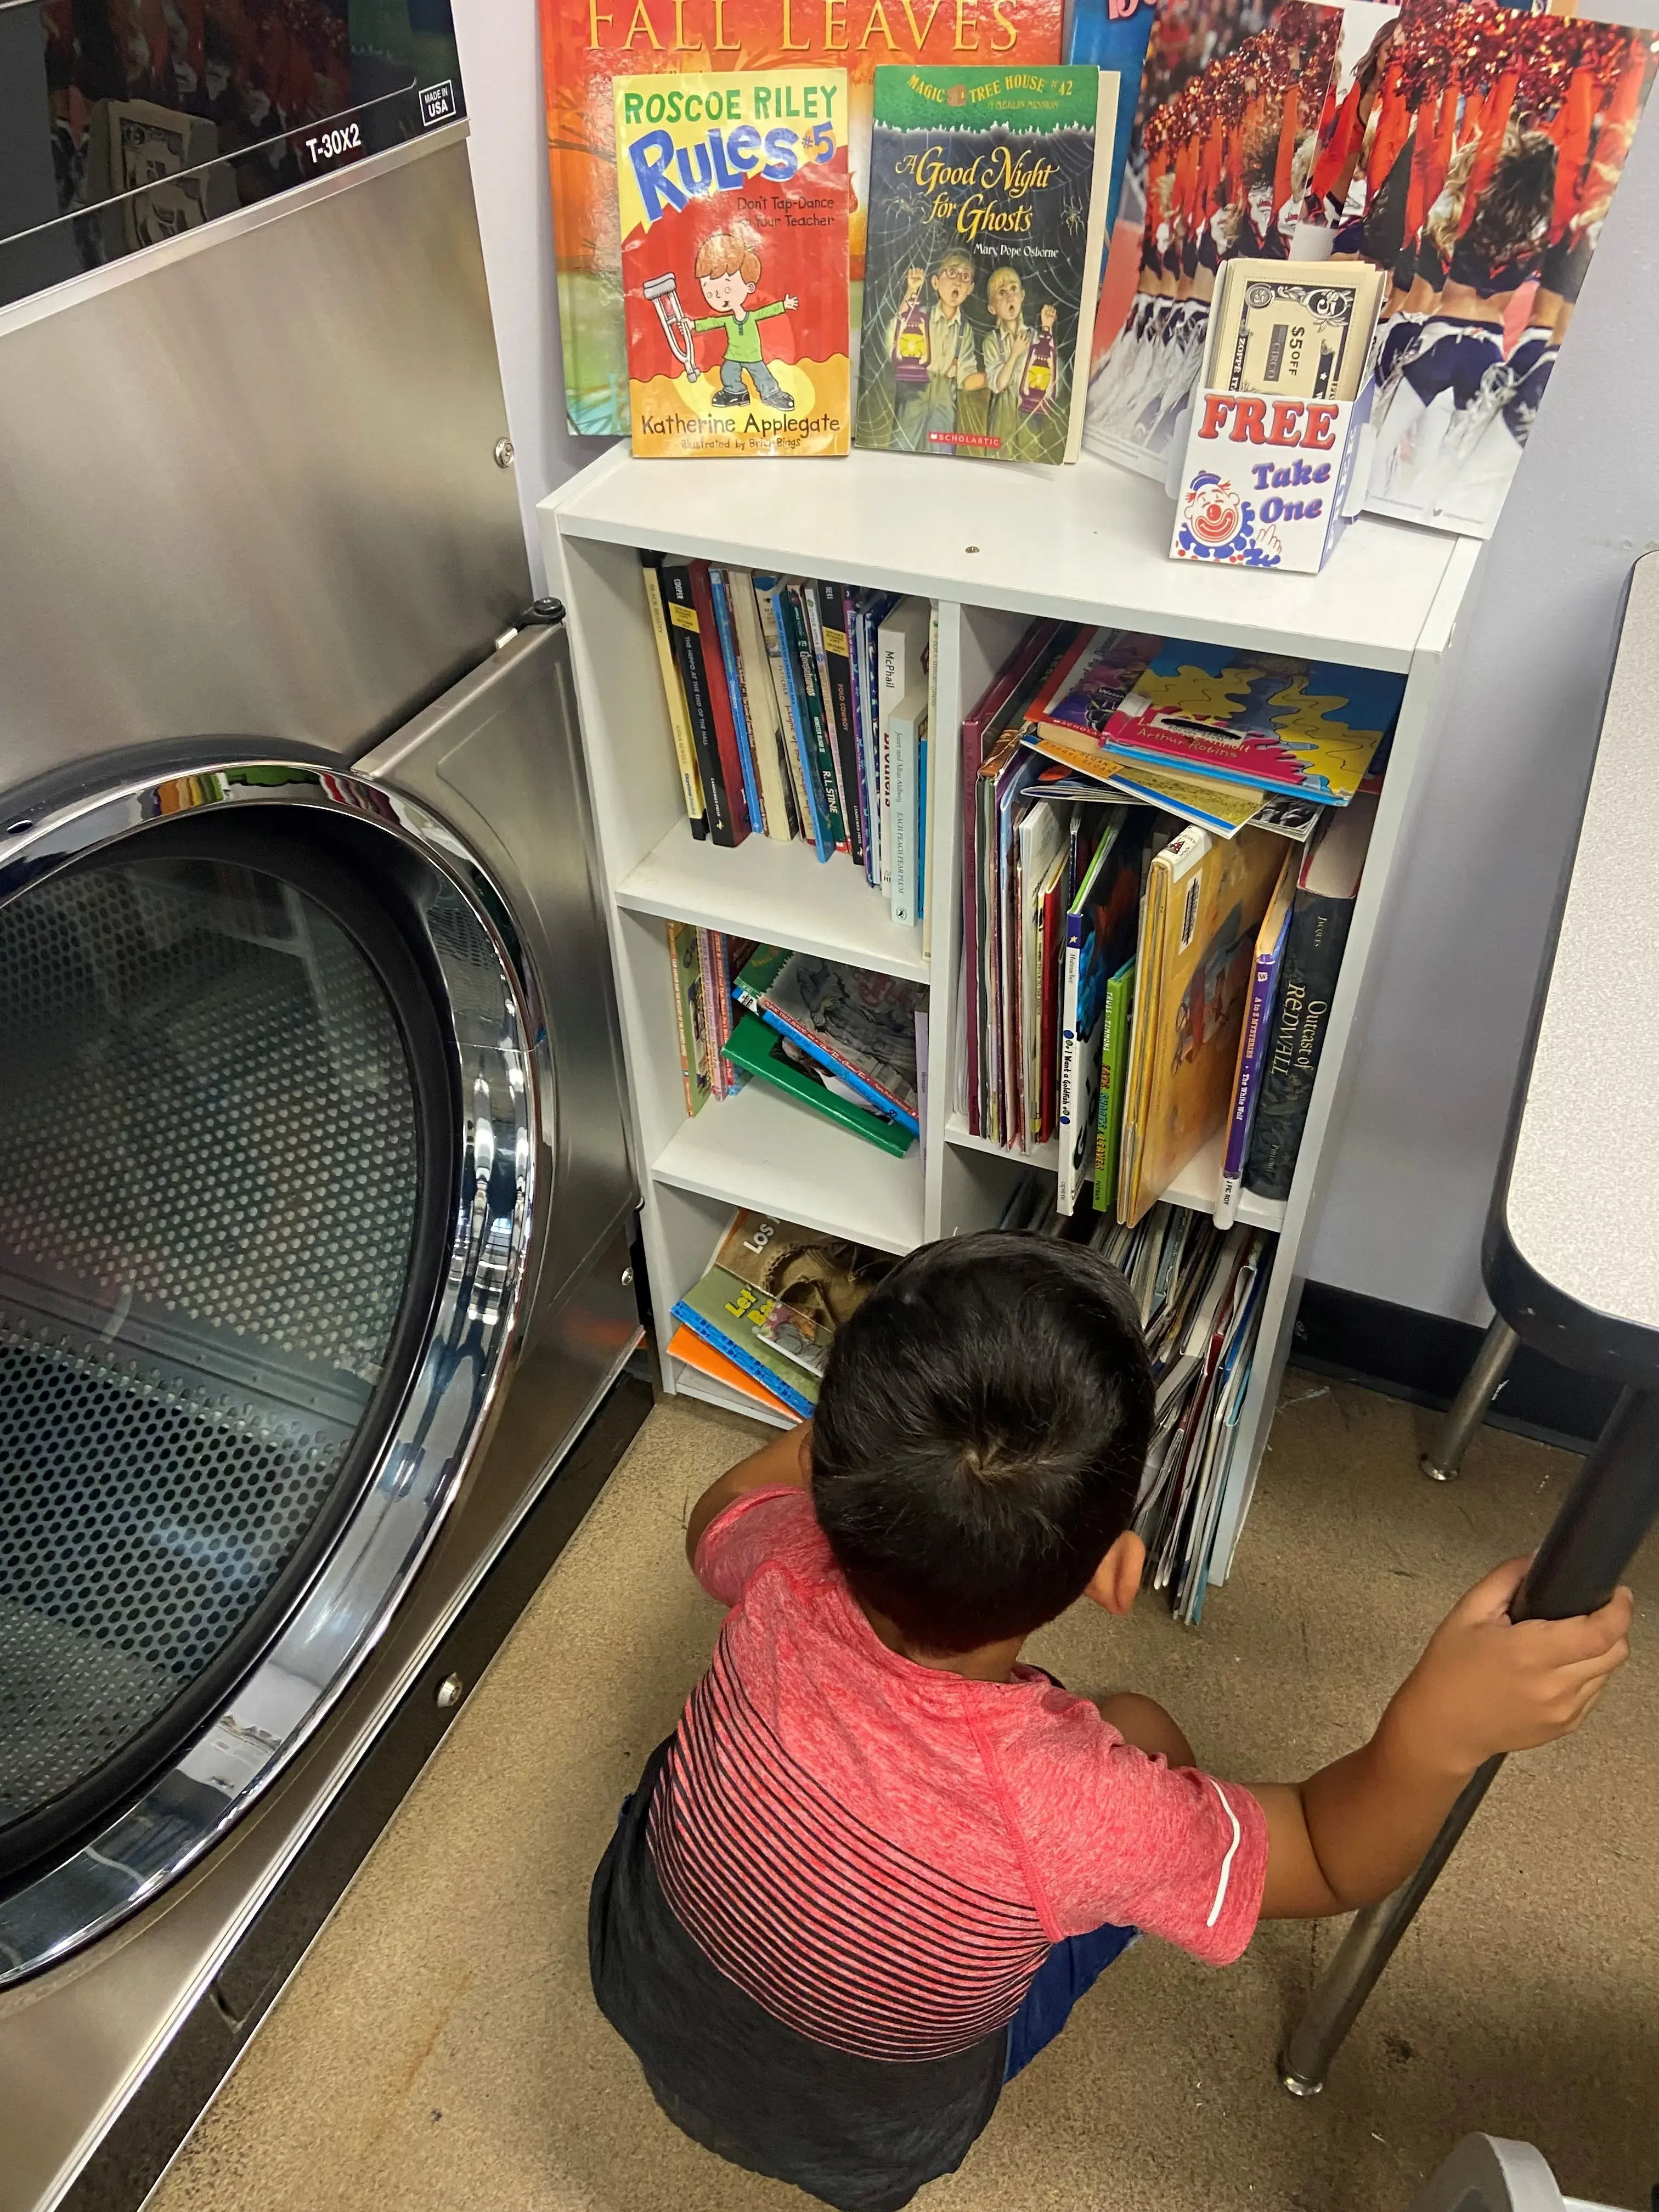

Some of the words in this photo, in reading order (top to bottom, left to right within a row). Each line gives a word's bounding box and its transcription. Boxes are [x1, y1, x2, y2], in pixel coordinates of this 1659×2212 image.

[587, 0, 742, 51] FALL
[780, 0, 1018, 51] LEAVES
[424, 89, 441, 104] MADE
[442, 87, 448, 97] IN
[907, 74, 946, 103] MAGIC
[969, 81, 1001, 103] TREE
[1005, 74, 1045, 93] HOUSE
[428, 99, 449, 117] USA
[624, 89, 741, 124] ROSCOE
[754, 85, 838, 120] RILEY
[306, 123, 362, 163] T-30X2
[895, 154, 918, 174] A
[916, 146, 985, 196] Good
[981, 146, 1060, 198] Night
[737, 196, 767, 210] Don't
[772, 196, 834, 212] Tap-Dance
[755, 216, 781, 227] Your
[784, 215, 834, 227] Teacher
[922, 192, 957, 224] for
[957, 194, 1033, 242] Ghosts
[974, 244, 999, 257] Mary
[1001, 245, 1022, 257] Pope
[1024, 245, 1058, 257] Osborne
[1290, 325, 1305, 349] $5
[1234, 337, 1246, 373] ZOPPE
[1268, 342, 1280, 379] CIRCO
[1289, 351, 1300, 376] OFF
[641, 413, 735, 435] Katherine
[744, 413, 840, 438] Applegate
[1198, 394, 1339, 450] FREE
[681, 438, 730, 449] illustrated
[735, 440, 746, 450] by
[777, 438, 801, 449] Biggs
[939, 434, 998, 445] SCHOLASTIC
[1252, 459, 1331, 490] Take
[1260, 496, 1323, 524] One
[674, 578, 684, 600] COOPER
[648, 584, 658, 606] BLACK
[653, 608, 664, 634] BEAUTY
[686, 649, 696, 670] HIPPO
[884, 651, 895, 688] McPhail
[691, 672, 697, 680] AT
[778, 664, 788, 695] FLETCHER
[799, 650, 819, 697] Goosebumps
[694, 694, 702, 707] END
[837, 683, 845, 701] POLO
[697, 708, 704, 717] OF
[839, 702, 850, 731] COWBOY
[701, 730, 709, 746] HALL
[1137, 727, 1184, 745] Arthur
[1189, 741, 1238, 758] Robins
[822, 770, 832, 786] R.L.
[826, 787, 838, 814] STINE
[895, 780, 904, 802] Ahlberg
[1105, 991, 1114, 1014] TRUSS
[1102, 1020, 1113, 1052] TIMMONS
[1245, 1018, 1260, 1059] MYSTERIES
[1299, 1000, 1328, 1056] Outcast
[1063, 1056, 1072, 1073] Want
[1293, 1056, 1316, 1071] of
[1061, 1079, 1072, 1105] Goldfish
[1241, 1073, 1251, 1086] The
[1237, 1086, 1248, 1106] White
[1098, 1092, 1110, 1128] SHOOTS
[1234, 1105, 1245, 1121] Wolf
[1094, 1136, 1108, 1170] LEAVES
[1222, 1194, 1231, 1205] ROY
[1224, 1184, 1233, 1193] FIC
